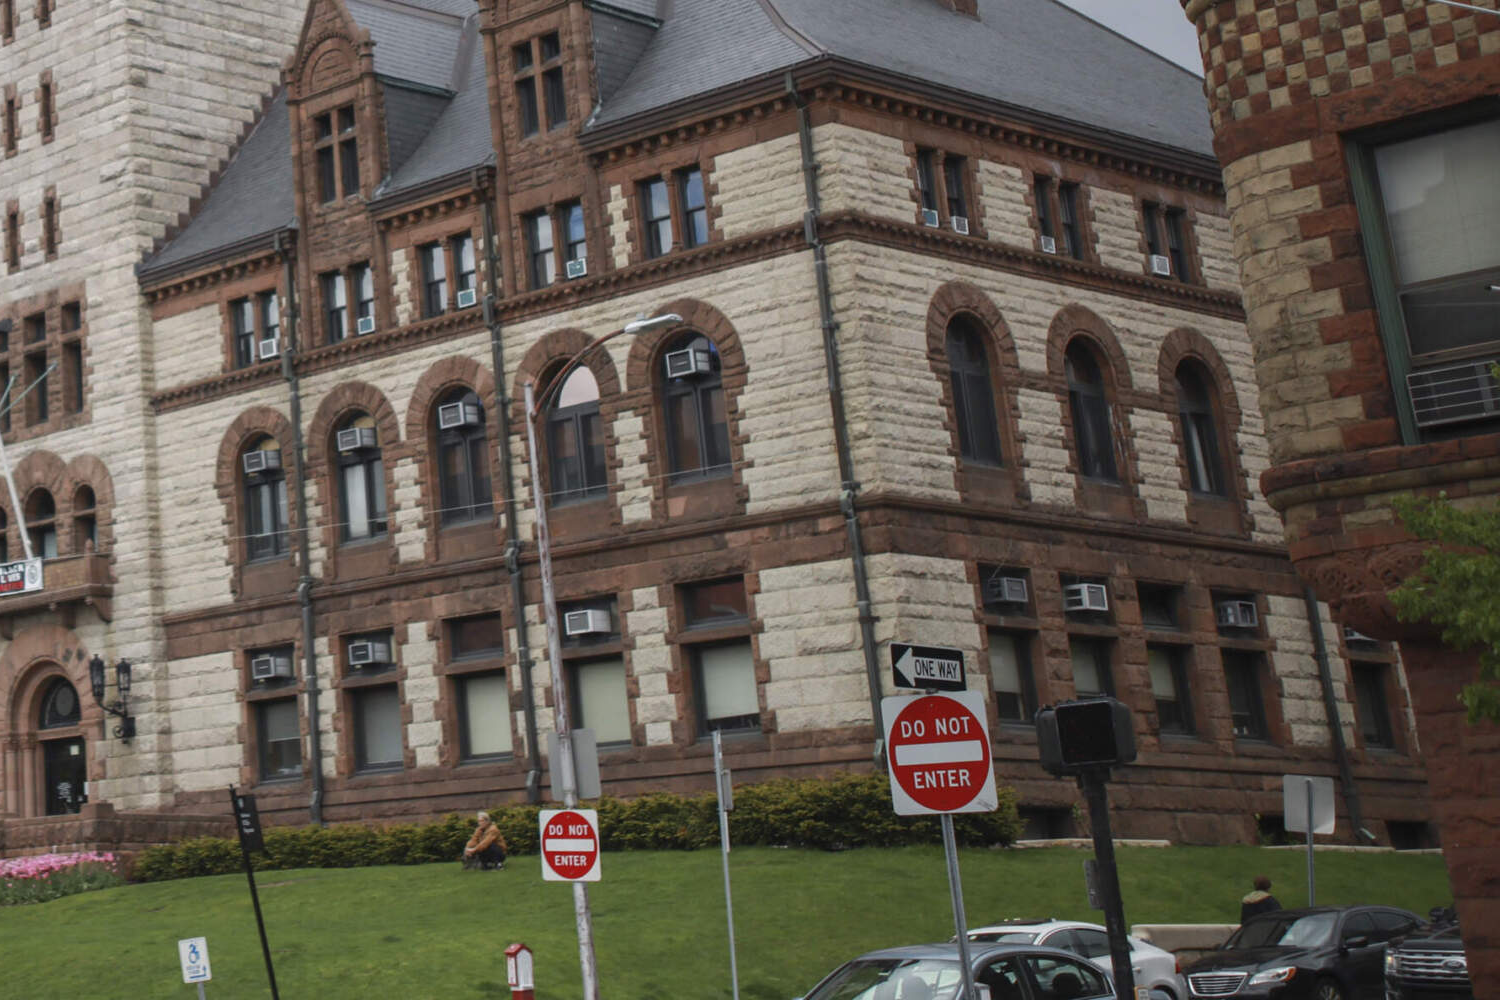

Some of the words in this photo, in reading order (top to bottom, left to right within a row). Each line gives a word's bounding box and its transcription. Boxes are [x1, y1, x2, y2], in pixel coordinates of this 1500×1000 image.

[0, 573, 21, 584] LVES
[914, 659, 935, 677] ONE
[937, 661, 958, 679] WAY
[900, 720, 925, 738] DO
[934, 716, 970, 736] NOT
[913, 769, 972, 789] ENTER
[548, 824, 563, 835] DO
[569, 824, 588, 835] NOT
[554, 855, 586, 866] ENTER
